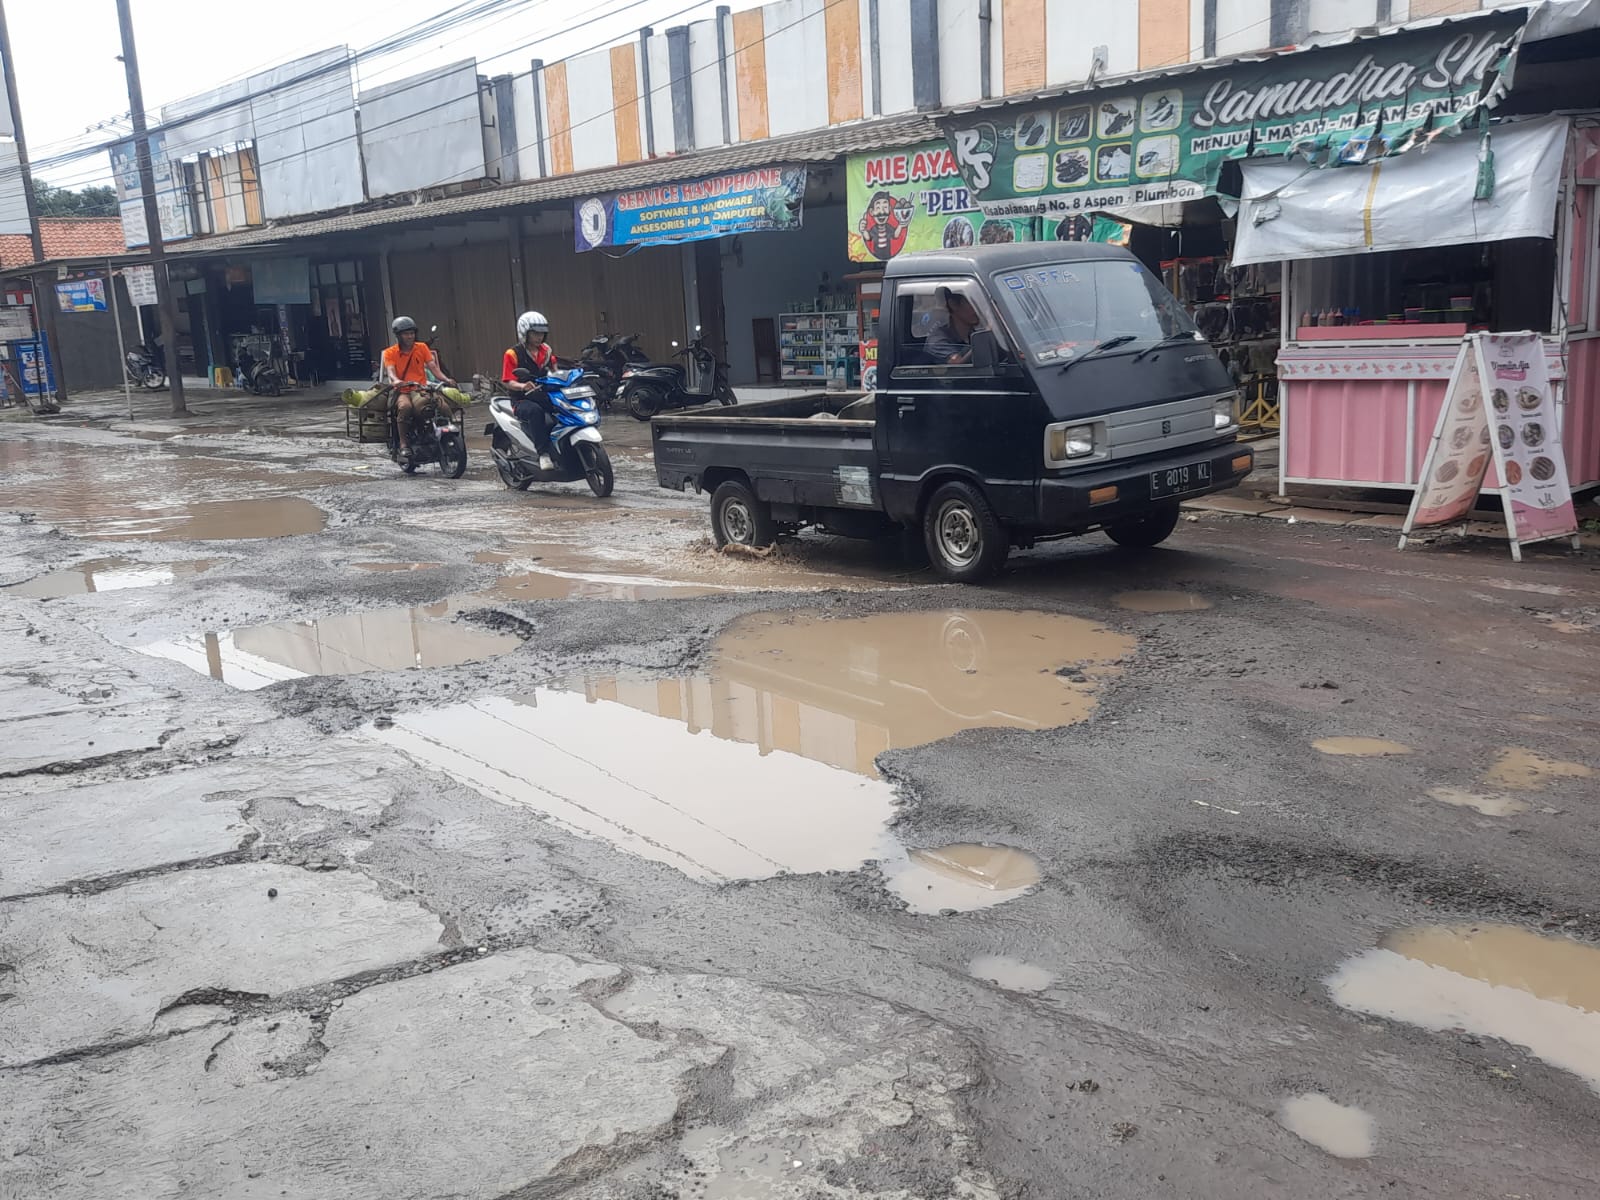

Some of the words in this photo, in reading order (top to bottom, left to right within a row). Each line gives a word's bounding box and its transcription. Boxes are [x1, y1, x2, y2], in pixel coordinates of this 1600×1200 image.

[1193, 54, 1416, 127] Samudra
[1422, 31, 1499, 88] Sh
[1192, 129, 1263, 153] MENJUAL
[1267, 118, 1326, 142] MACAM
[1340, 107, 1405, 128] MACAM
[866, 153, 908, 184] MIE
[912, 149, 959, 178] AYA
[617, 184, 679, 211] SERVICE
[681, 167, 782, 202] HANDPHONE
[1049, 199, 1070, 213] No.
[1073, 197, 1081, 209] 8
[1084, 194, 1124, 210] Aspen
[1135, 185, 1196, 204] Plumbon
[630, 219, 685, 235] AKSESORIES
[687, 217, 701, 228] HP
[703, 215, 710, 225] &
[639, 205, 689, 222] SOFTWARE
[691, 205, 698, 215] &
[1004, 269, 1080, 291] DAFFA
[1152, 472, 1159, 490] E
[1166, 466, 1189, 487] 8019
[1197, 463, 1210, 480] KL
